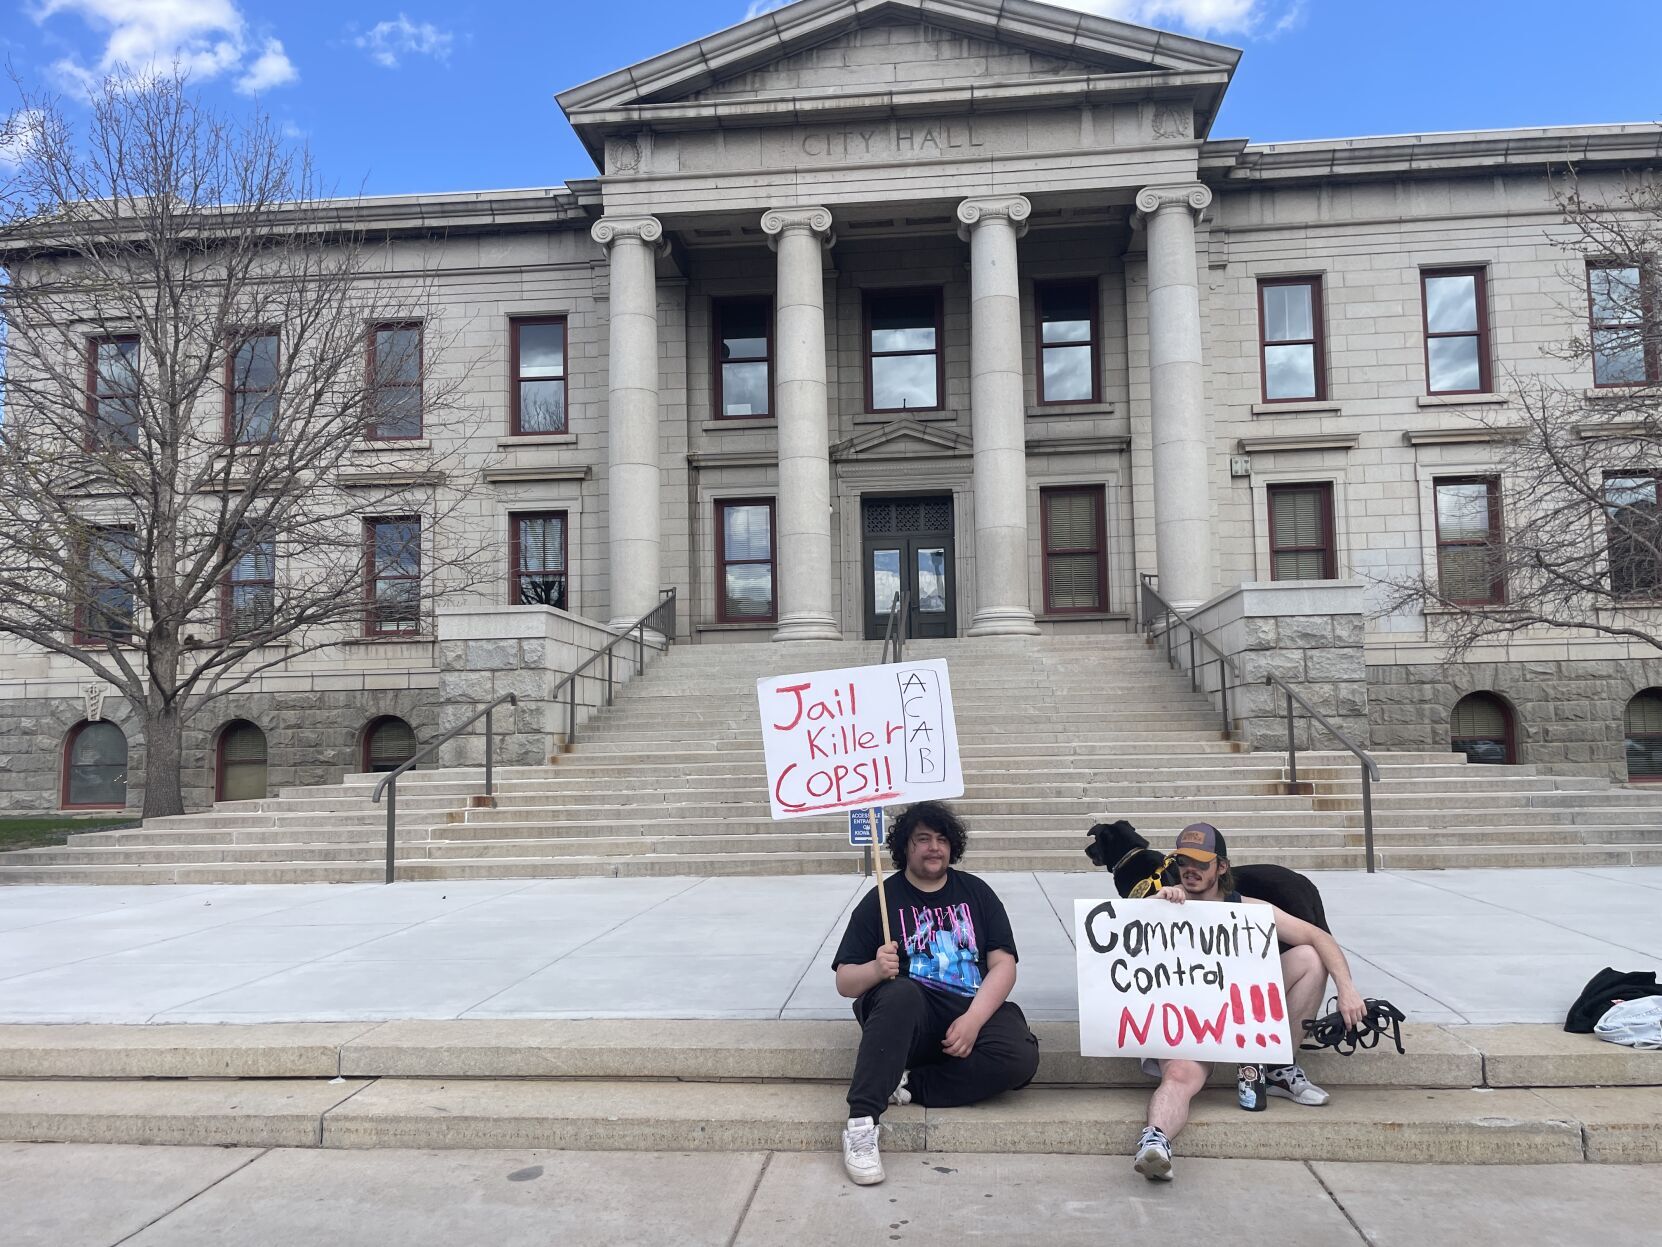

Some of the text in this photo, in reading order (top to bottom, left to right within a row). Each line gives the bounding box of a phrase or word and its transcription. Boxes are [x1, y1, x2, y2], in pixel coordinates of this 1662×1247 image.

[801, 124, 984, 156] CITY HALL
[773, 683, 856, 731] Jail
[806, 721, 904, 760] Killer
[1084, 901, 1276, 959] Community
[1118, 982, 1284, 1049] NOW!!!
